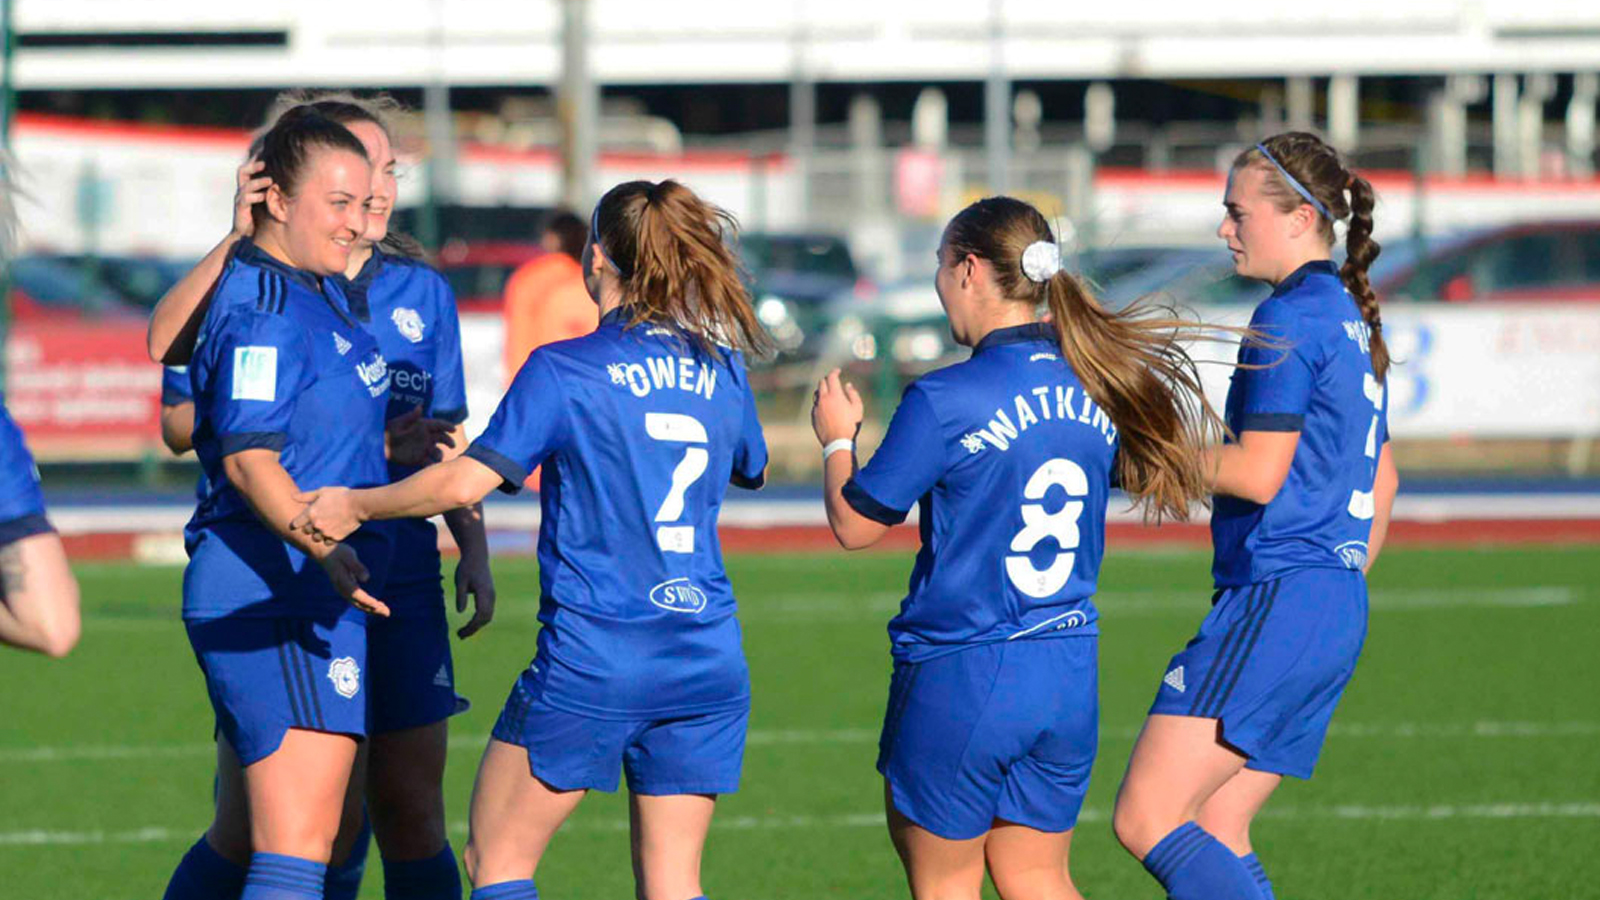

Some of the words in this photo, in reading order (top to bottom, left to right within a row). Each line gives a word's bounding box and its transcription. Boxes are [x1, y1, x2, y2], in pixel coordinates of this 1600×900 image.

[626, 355, 717, 401] OWEN
[645, 412, 709, 554] 2
[1005, 457, 1089, 598] 8
